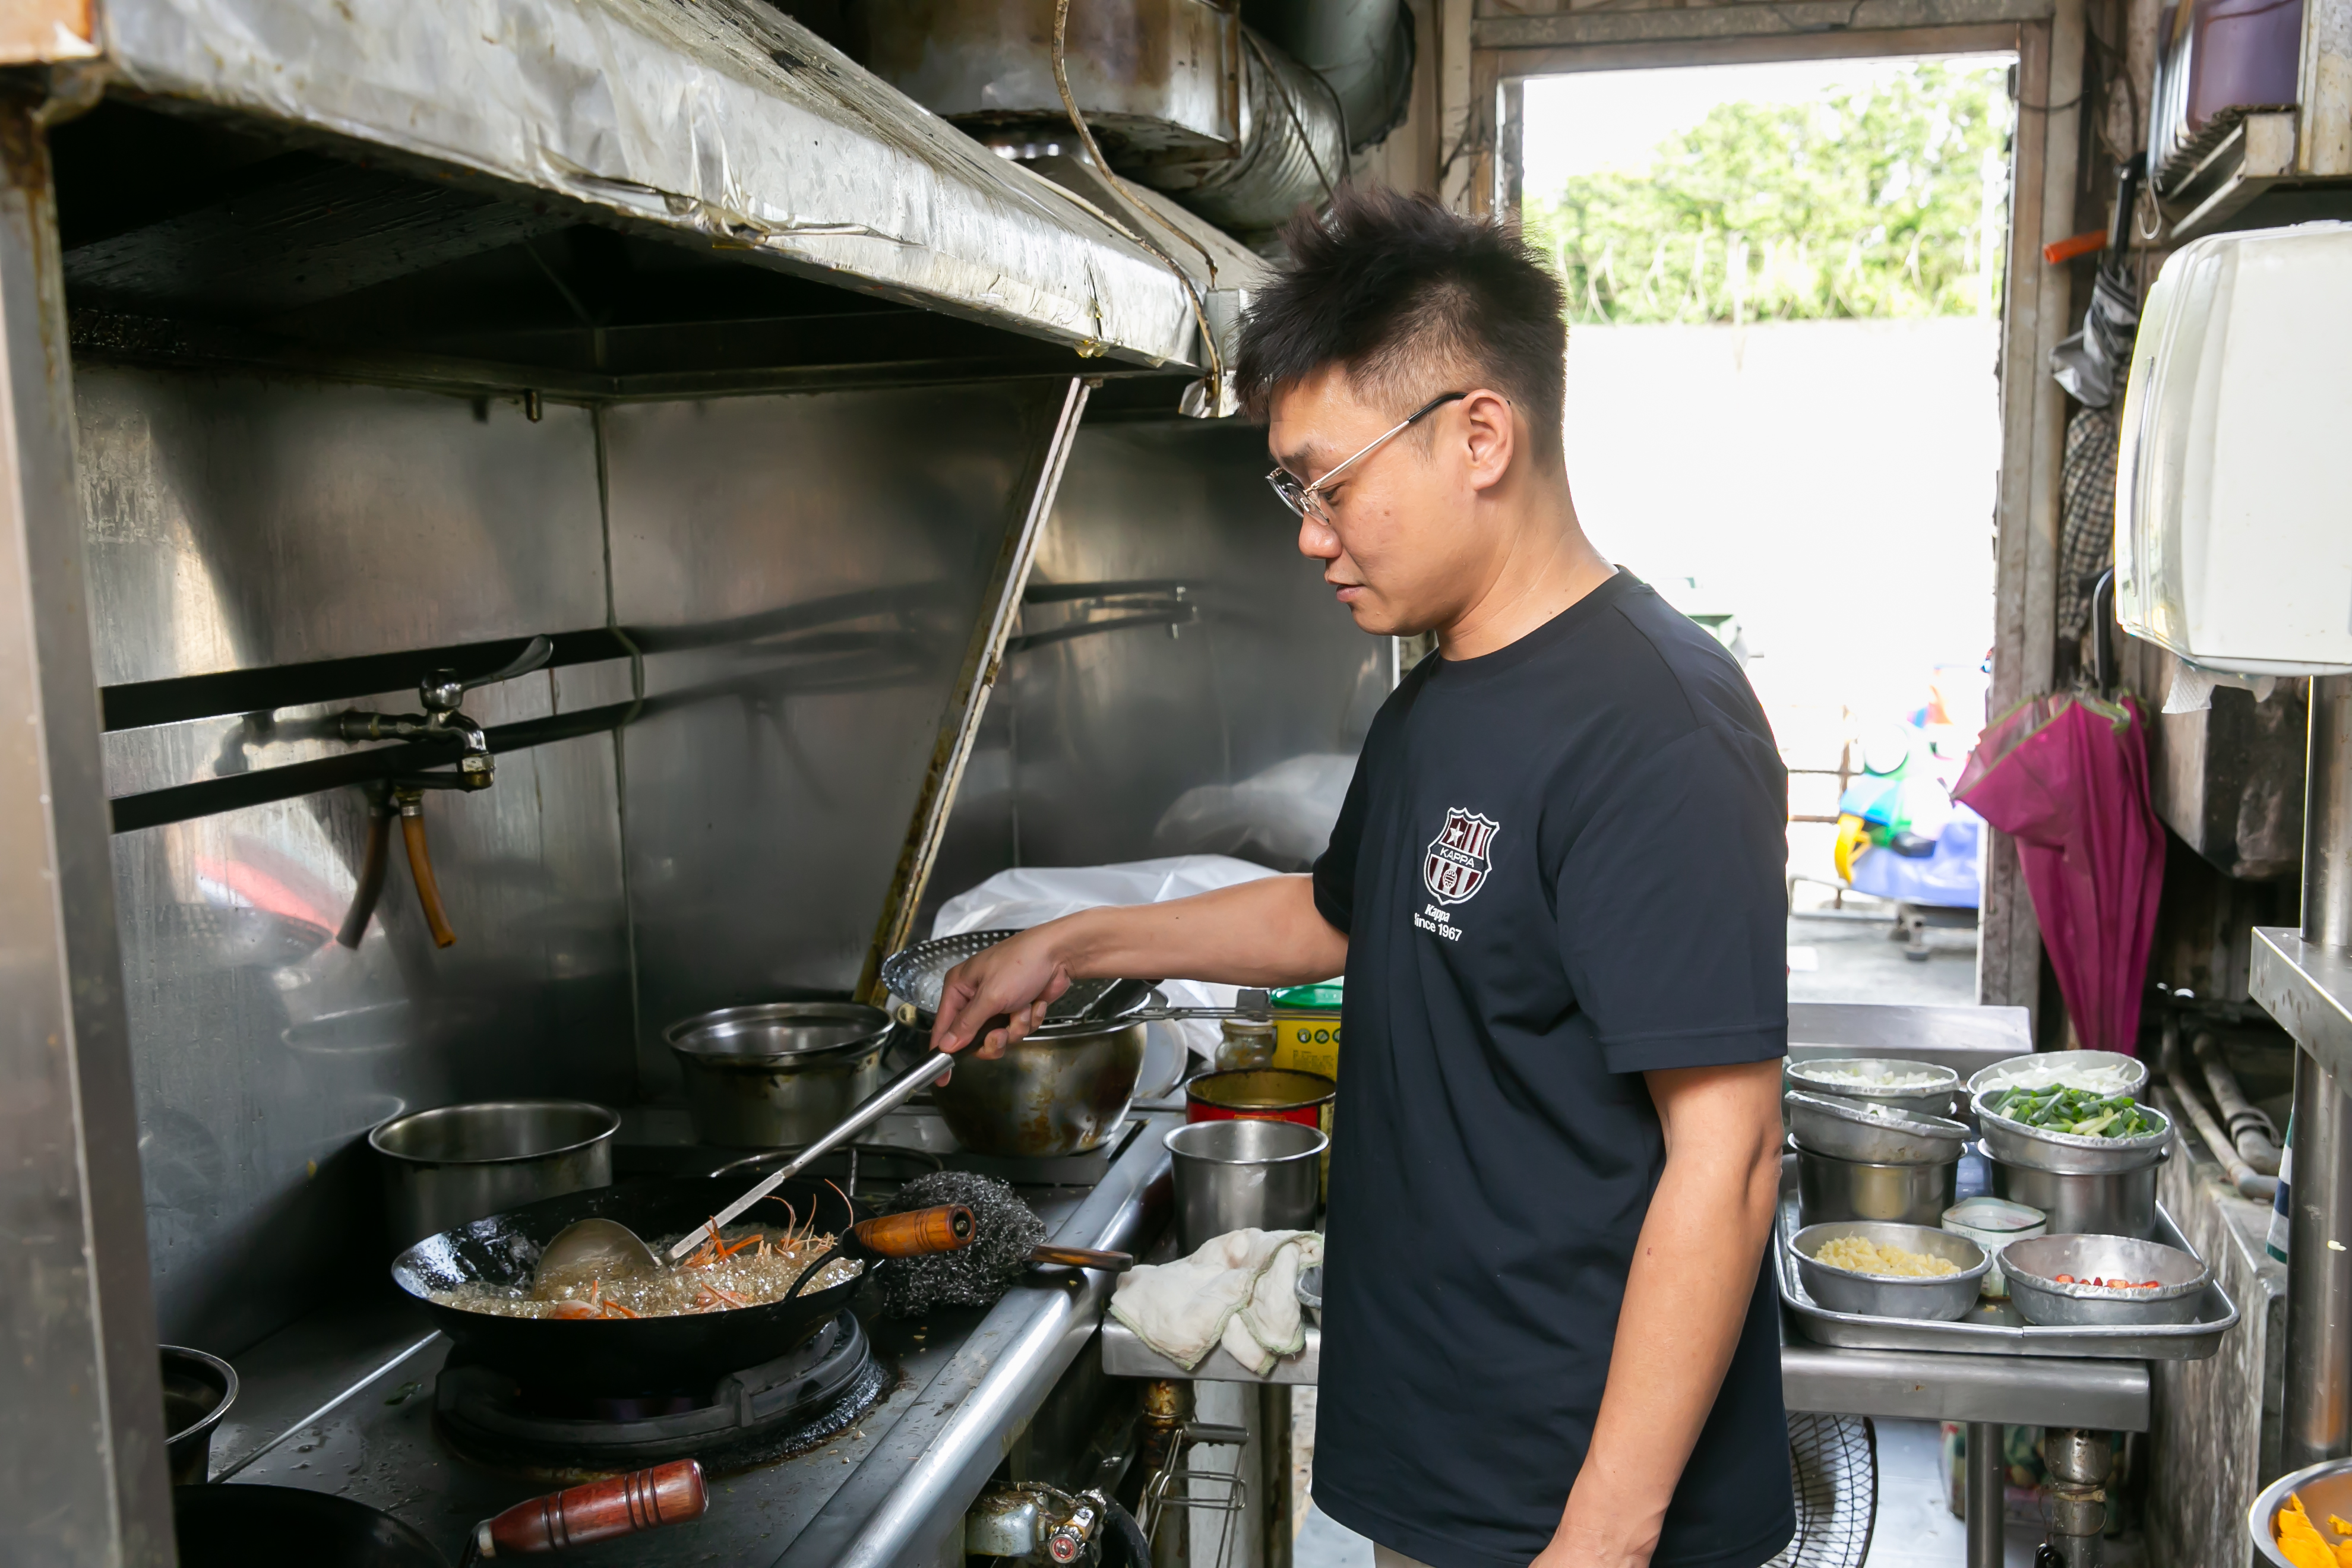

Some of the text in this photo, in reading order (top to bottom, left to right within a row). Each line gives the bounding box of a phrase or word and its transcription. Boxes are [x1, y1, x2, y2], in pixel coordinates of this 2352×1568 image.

[1440, 847, 1474, 868] KAPPA
[1424, 903, 1450, 922] Kappa
[1437, 923, 1462, 941] 1967
